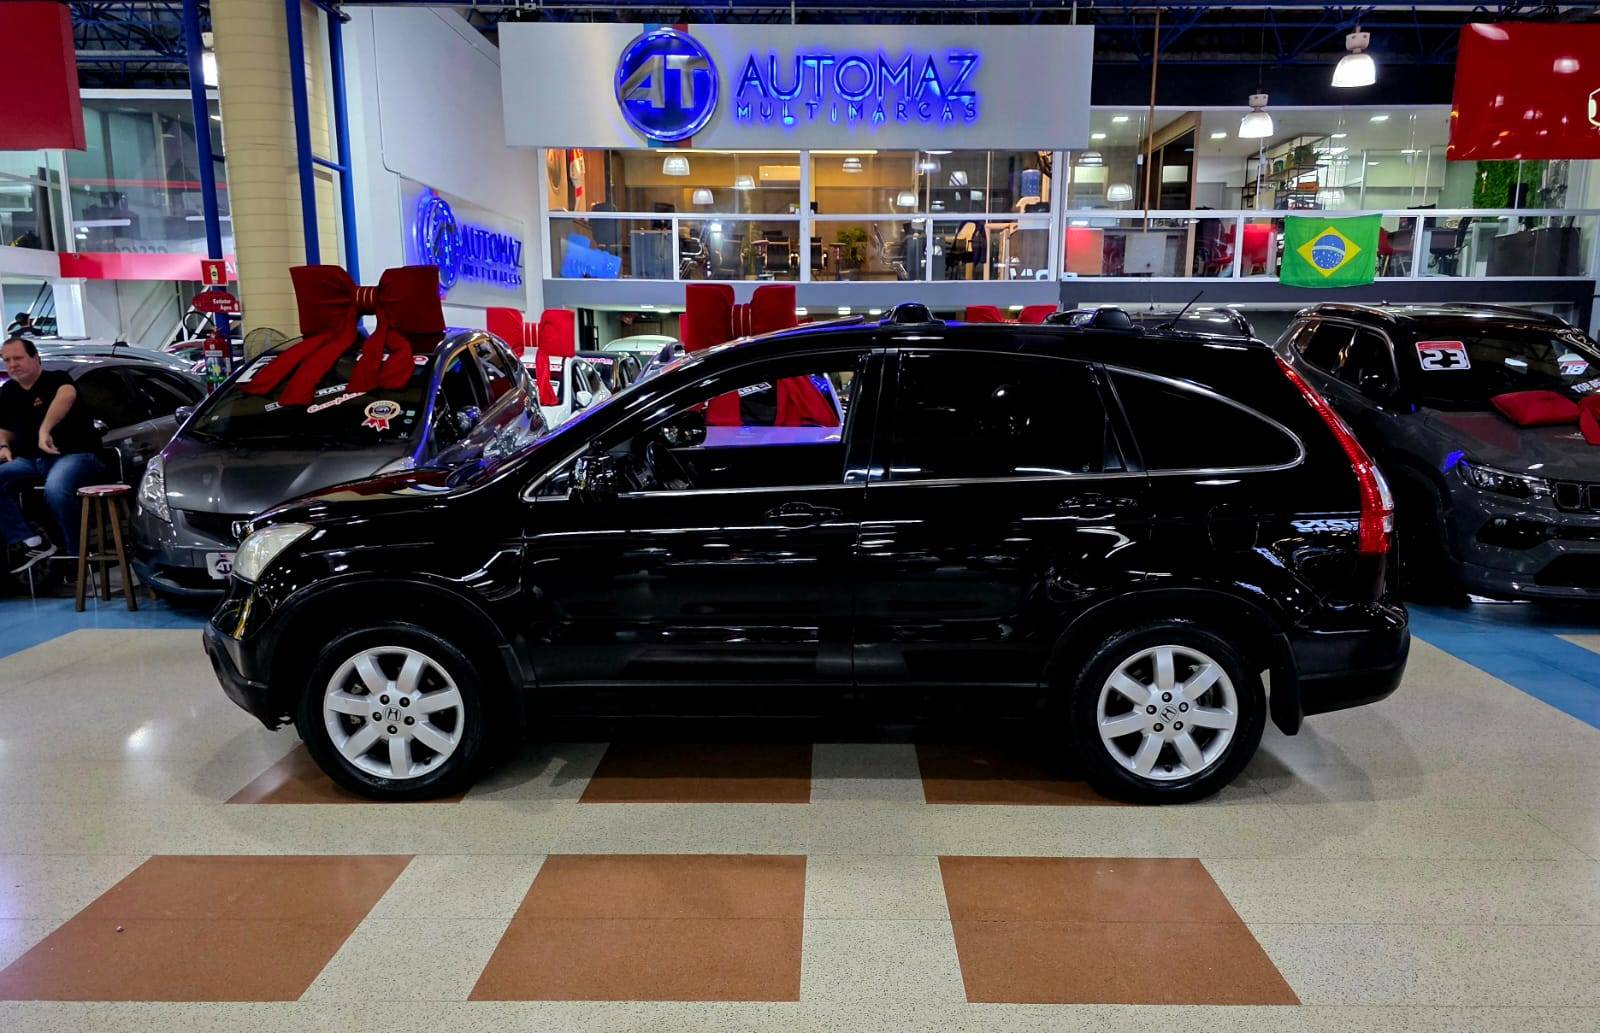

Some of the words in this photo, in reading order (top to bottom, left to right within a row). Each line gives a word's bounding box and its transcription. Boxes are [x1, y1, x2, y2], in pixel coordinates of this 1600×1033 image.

[736, 54, 979, 98] AUTOMAZ
[736, 102, 977, 121] MULTIMARCAS
[462, 224, 522, 268] AUTOMAZ
[1422, 349, 1468, 368] 23
